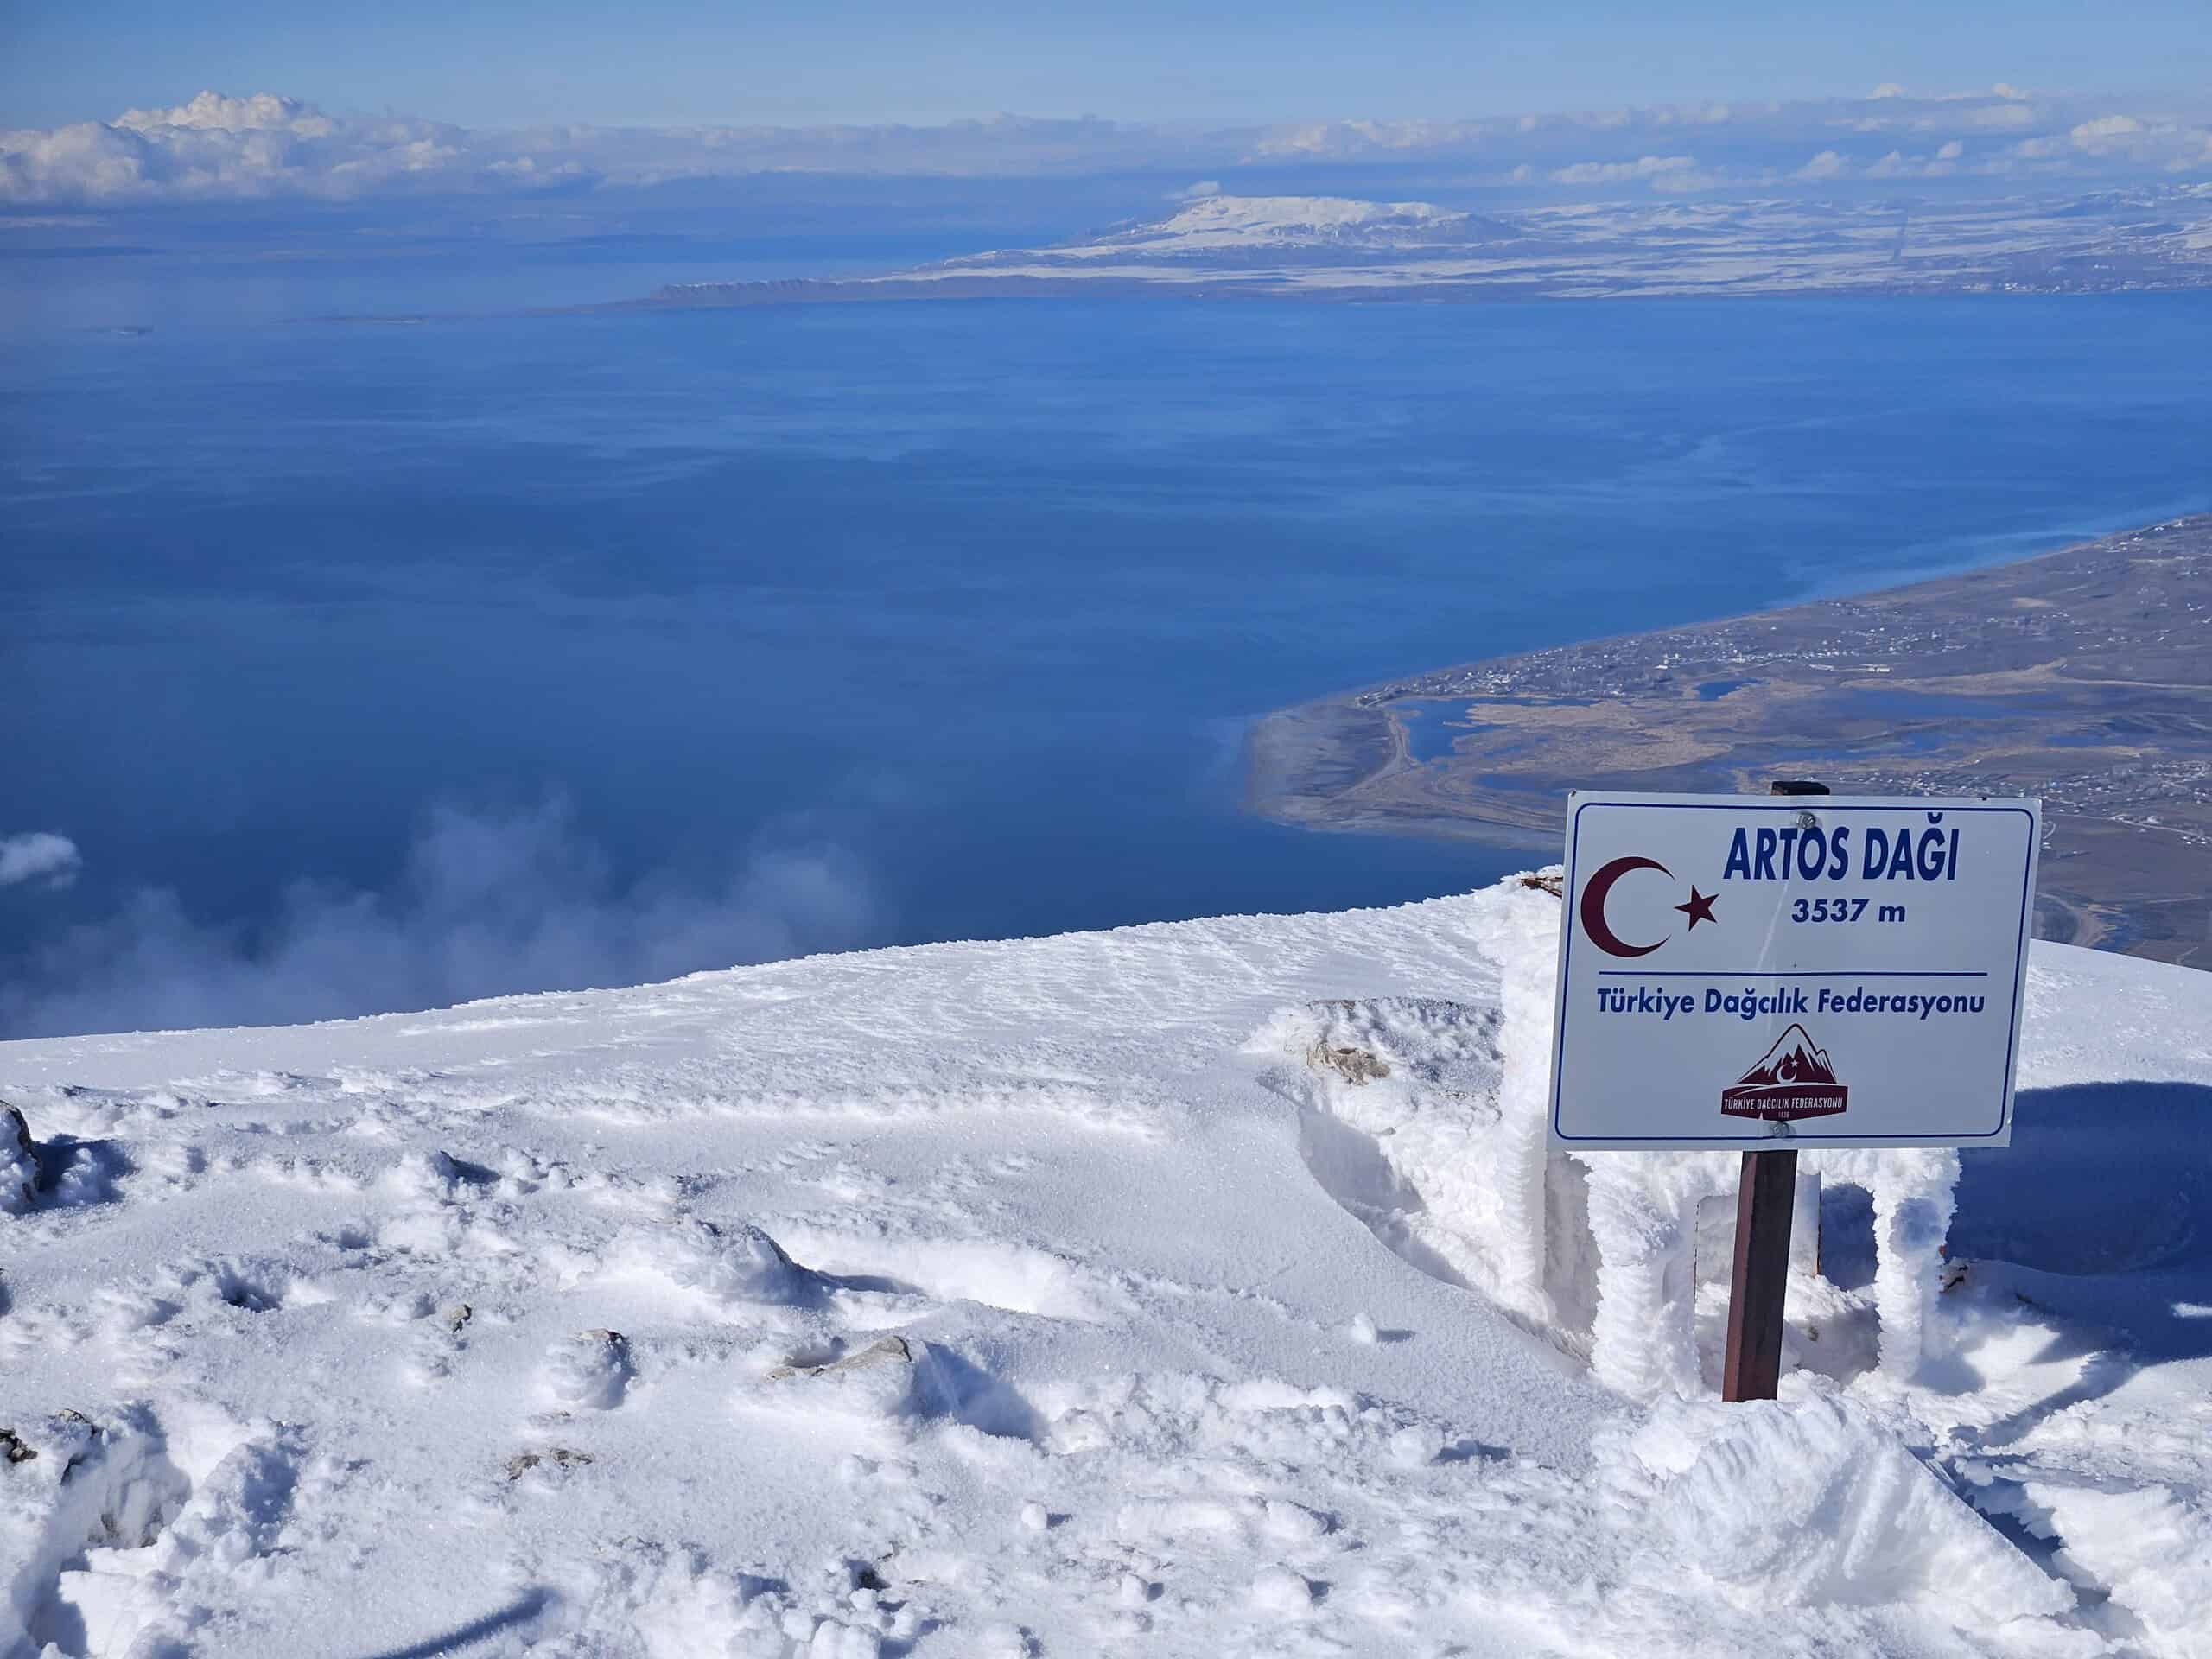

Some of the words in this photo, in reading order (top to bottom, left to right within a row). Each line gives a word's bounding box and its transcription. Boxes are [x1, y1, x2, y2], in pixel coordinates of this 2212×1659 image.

[1723, 825, 1851, 881] ARTOS
[1861, 811, 1960, 881] DAĞI
[1791, 898, 1871, 923] 3537
[1878, 905, 1906, 923] m
[1597, 987, 1695, 1020] Türkiye
[1704, 988, 1809, 1020] Dağcılık
[1817, 987, 1985, 1020] Federasyonu
[1724, 1096, 1756, 1110] TÜRKİYE
[1791, 1096, 1843, 1109] FEDERASYONU
